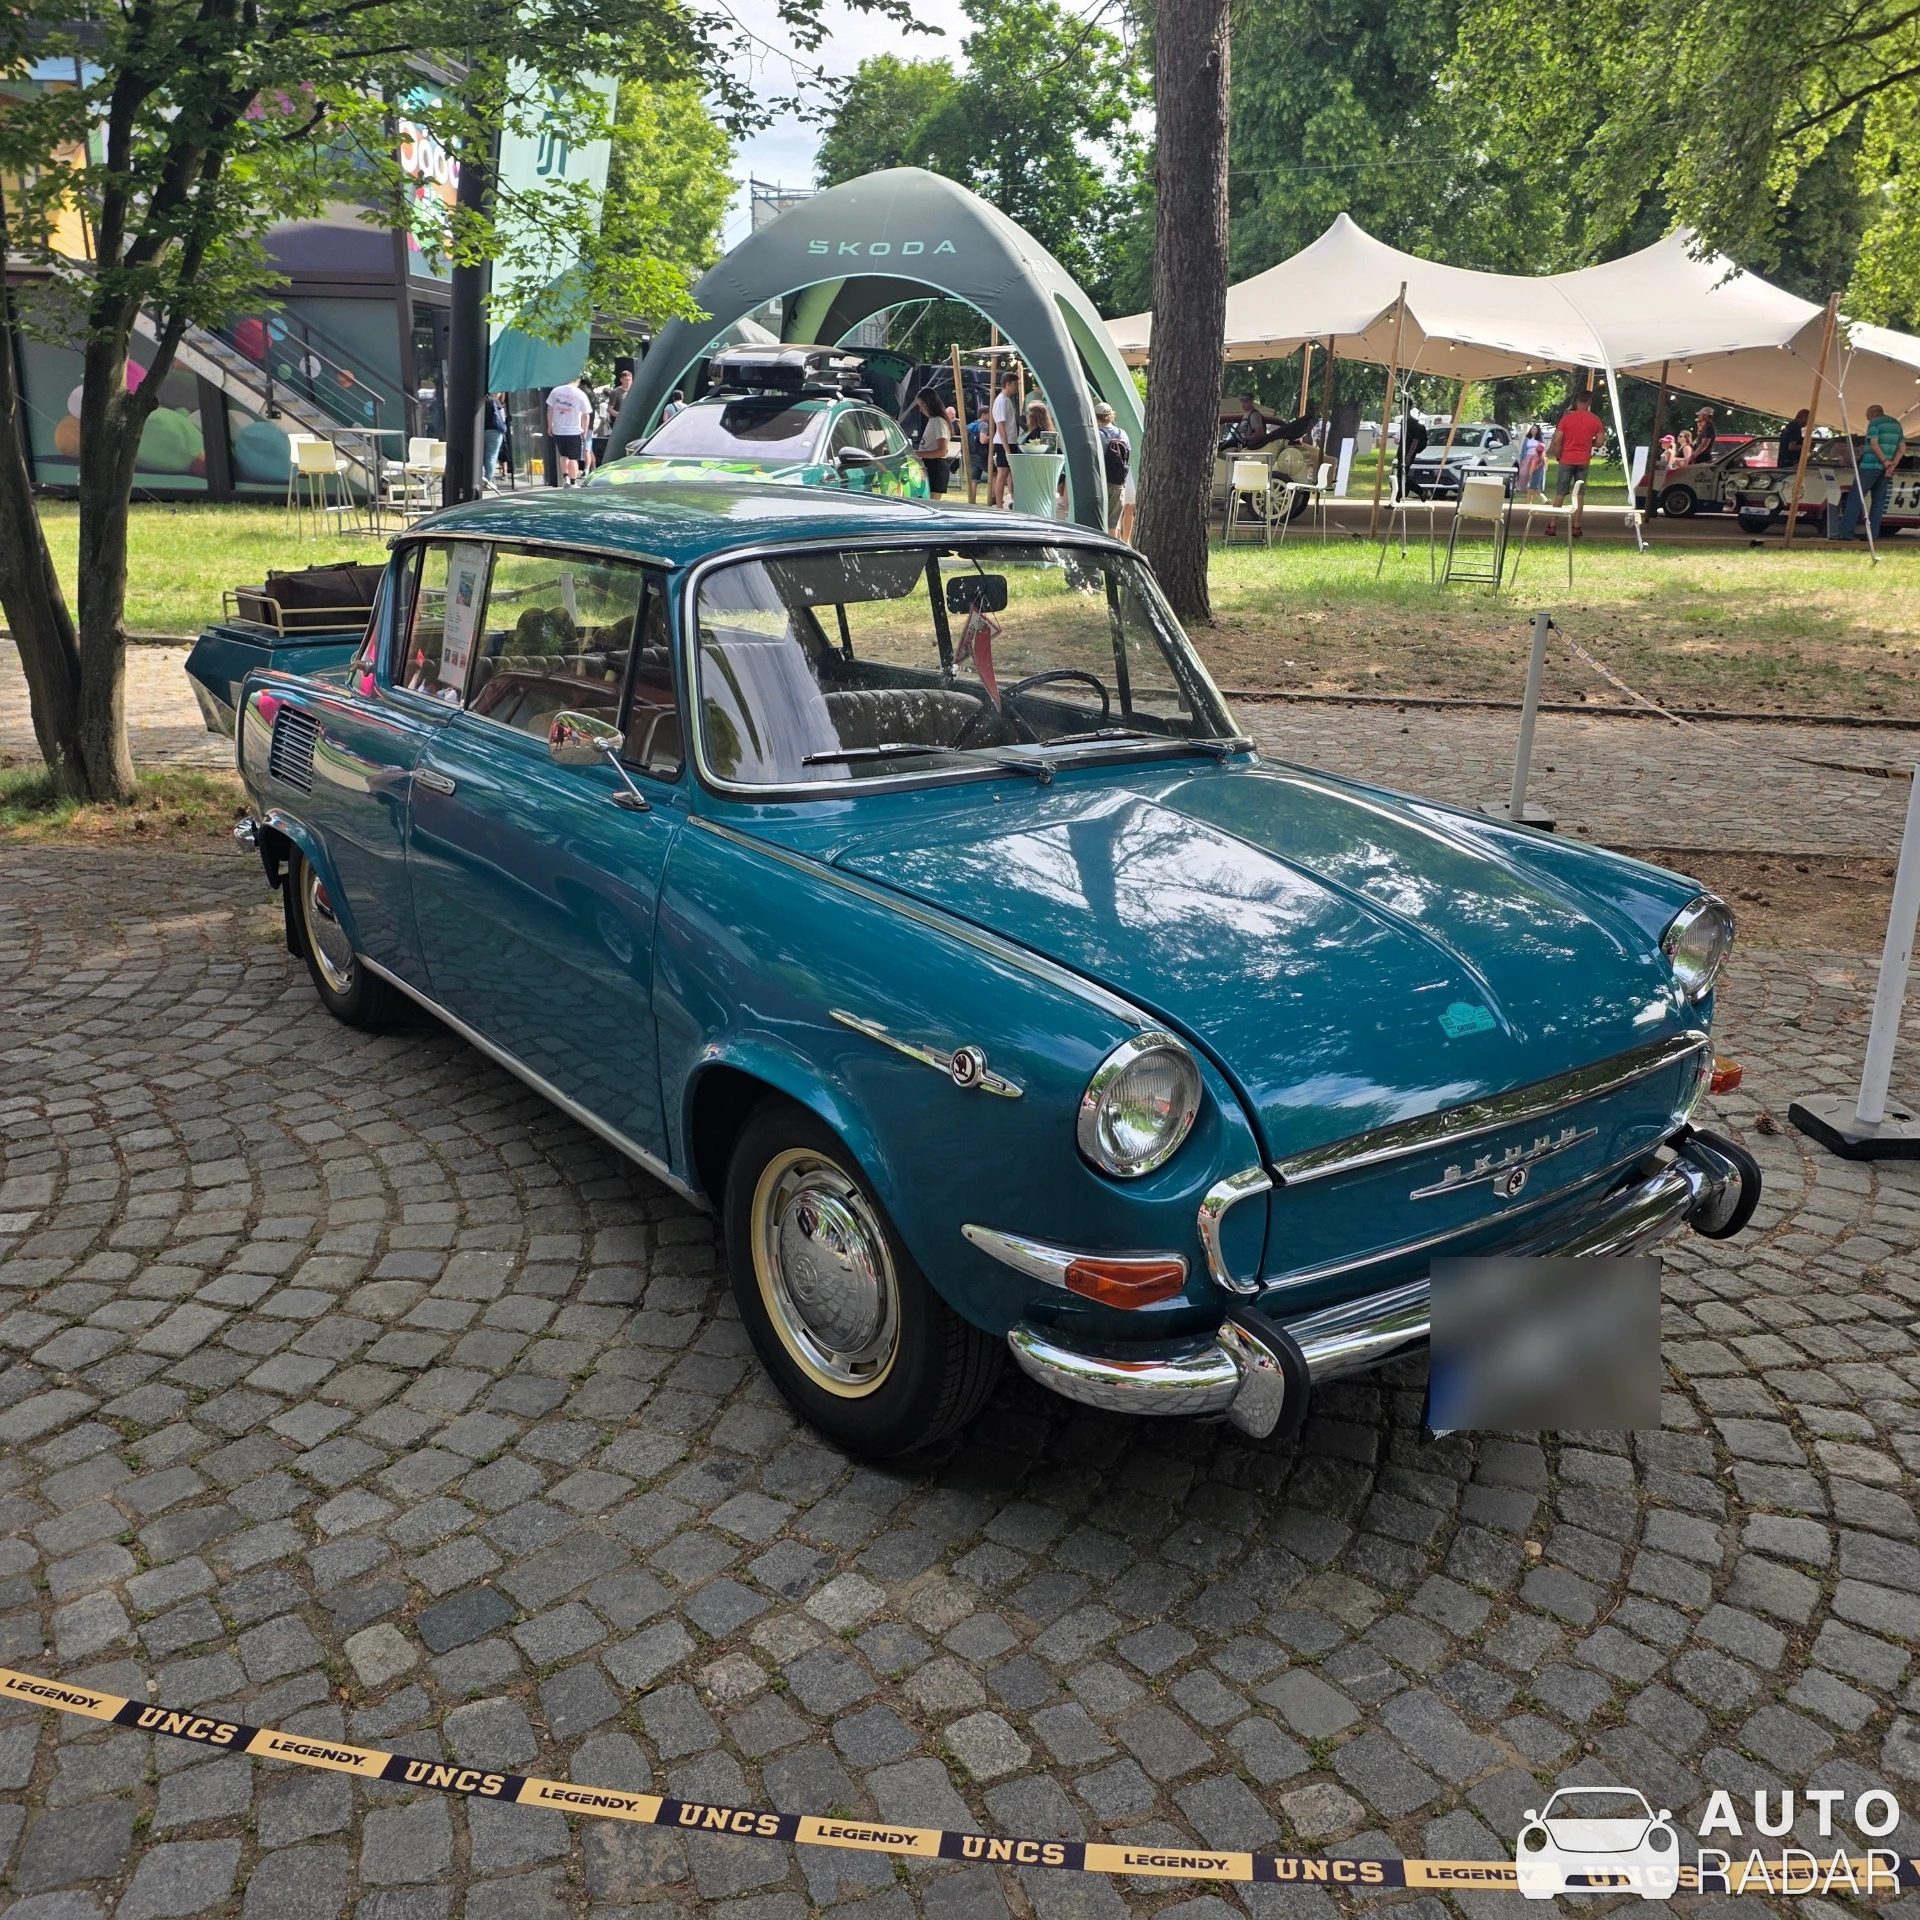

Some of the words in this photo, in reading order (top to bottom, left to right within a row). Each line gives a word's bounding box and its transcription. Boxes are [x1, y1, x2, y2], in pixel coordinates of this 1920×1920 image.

[5, 1678, 103, 1709] LEGENDY
[136, 1707, 239, 1744] UNCS
[268, 1738, 369, 1766] LEGENDY
[404, 1760, 506, 1796] UNCS
[539, 1786, 640, 1812] LEGENDY
[678, 1803, 781, 1836] UNCS
[817, 1825, 919, 1846] LEGENDY
[962, 1835, 1065, 1865] UNCS
[1123, 1853, 1230, 1871] LEGENDY
[1274, 1857, 1385, 1883] UNCS
[1583, 1865, 1699, 1888] UNCS
